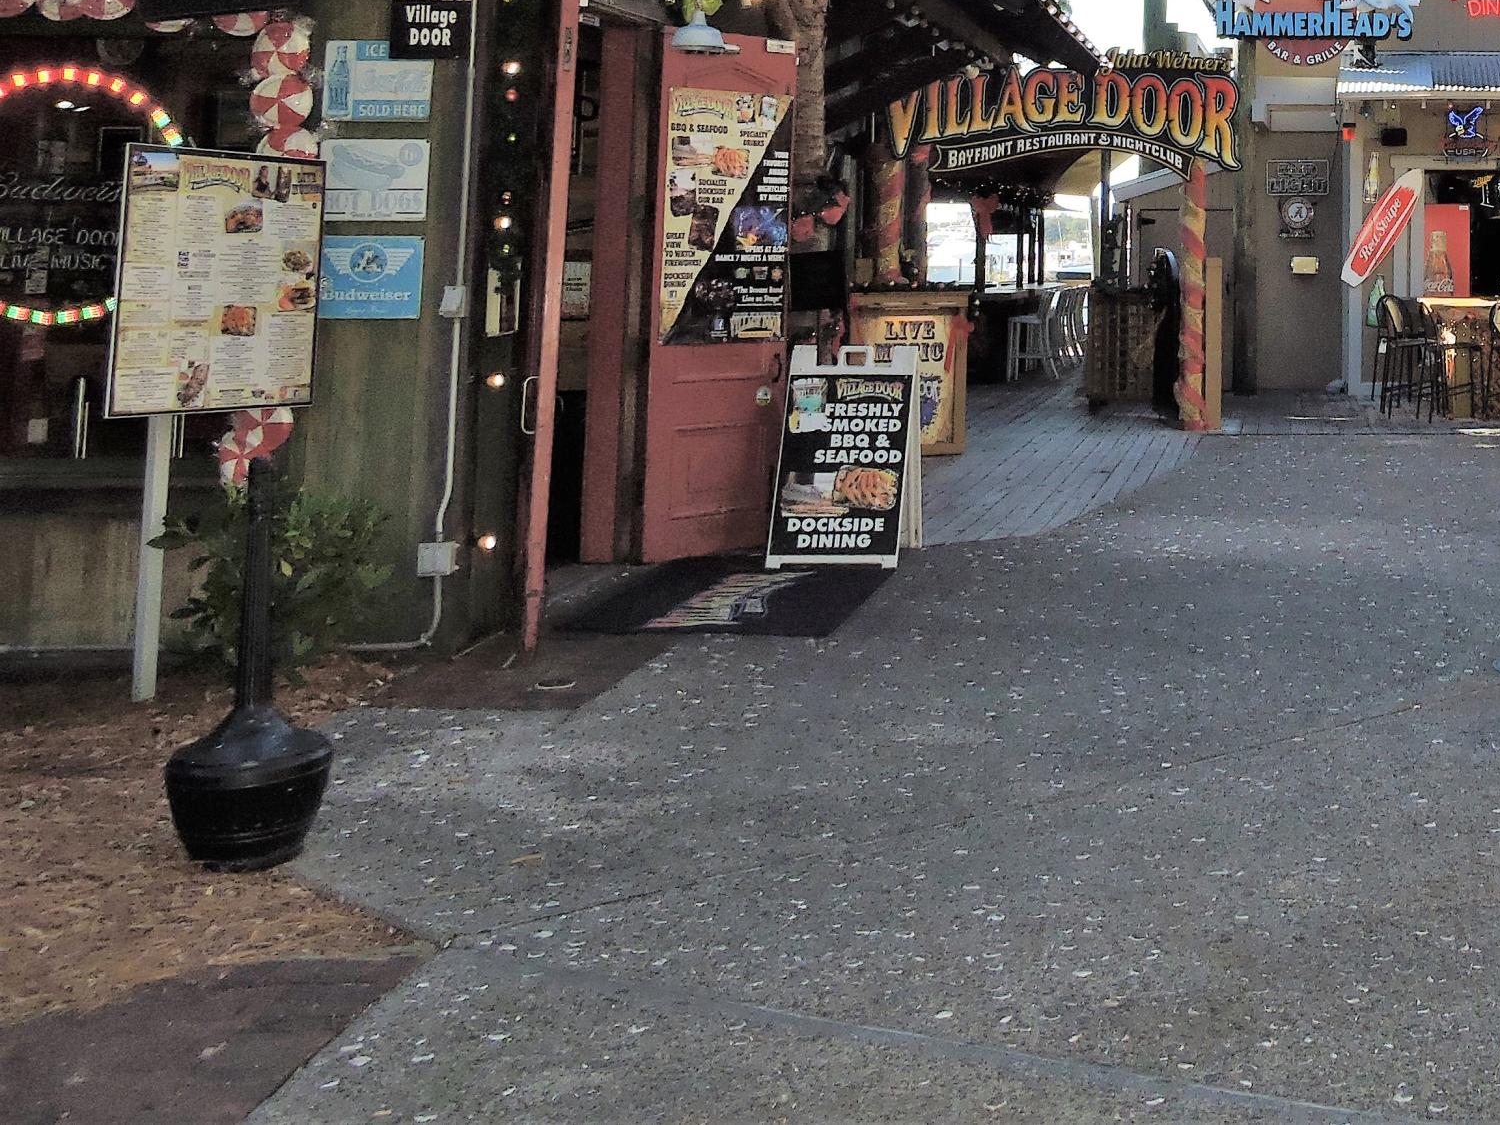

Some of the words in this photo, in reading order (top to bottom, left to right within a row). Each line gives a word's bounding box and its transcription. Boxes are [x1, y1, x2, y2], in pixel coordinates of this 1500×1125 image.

[405, 5, 457, 27] Village
[409, 28, 452, 46] DOOR
[365, 44, 388, 57] ICE
[1267, 41, 1289, 61] BAR
[1293, 55, 1301, 64] &
[1306, 41, 1344, 65] GRILLE
[1099, 47, 1151, 74] John
[1151, 50, 1234, 72] Wehner's
[359, 104, 391, 117] SOLD
[393, 104, 427, 118] HERE
[889, 64, 1087, 158] VILLAGE
[1088, 70, 1242, 170] DOOR
[671, 123, 687, 132] BBQ
[697, 124, 728, 134] SEAFOOD
[947, 141, 1013, 168] BAYFRONT
[1016, 132, 1098, 154] RESTAURANT
[1098, 133, 1111, 146] &
[1113, 135, 1183, 170] NIGHTCLUB
[1268, 178, 1329, 193] LIGHT
[1359, 235, 1380, 262] Red
[322, 288, 412, 301] Budweiser
[884, 320, 935, 340] LIVE
[874, 343, 944, 363] MIC
[835, 378, 875, 399] VILLAGE
[875, 381, 905, 402] DOOR
[825, 403, 904, 417] FRESHLY
[821, 419, 902, 432] SMOKED
[830, 434, 869, 449] BBQ
[875, 435, 890, 448] &
[814, 449, 902, 464] SEAFOOD
[787, 518, 885, 532] DOCKSIDE
[797, 534, 872, 548] DINING
